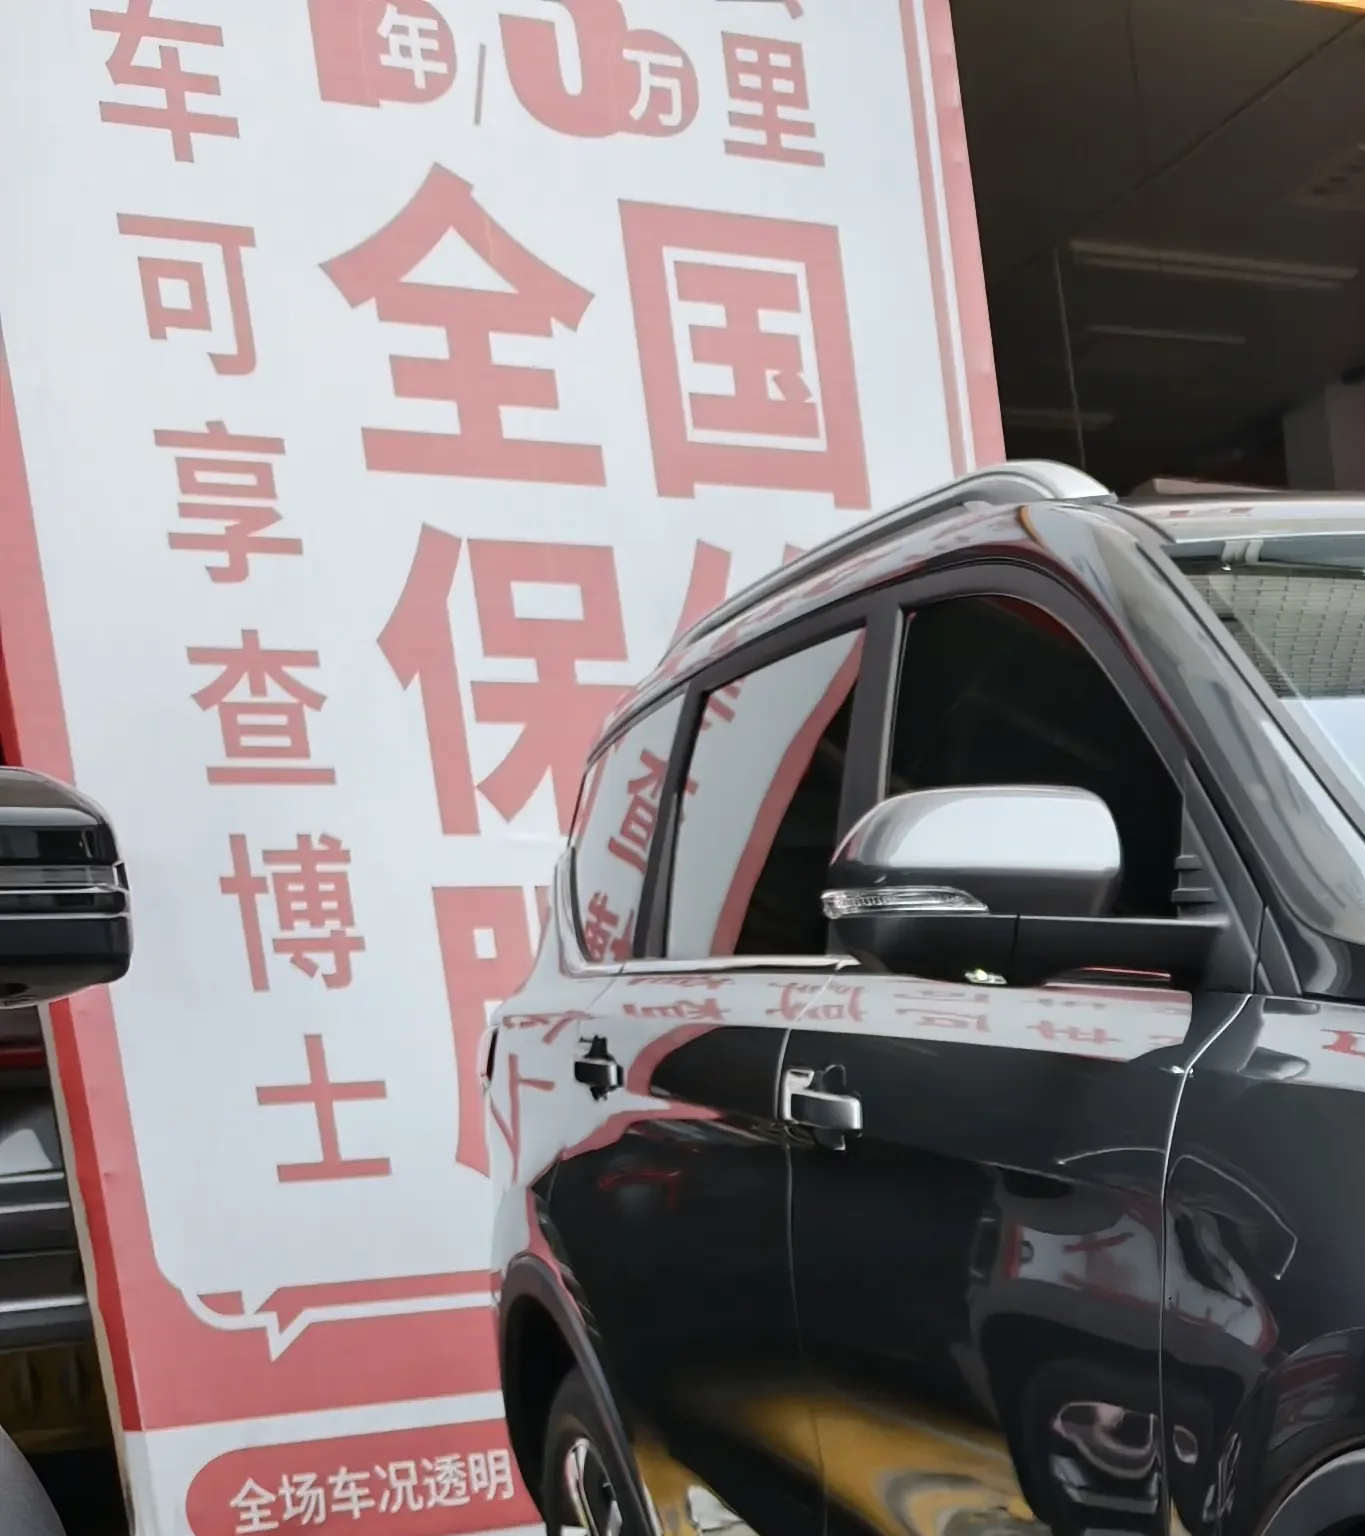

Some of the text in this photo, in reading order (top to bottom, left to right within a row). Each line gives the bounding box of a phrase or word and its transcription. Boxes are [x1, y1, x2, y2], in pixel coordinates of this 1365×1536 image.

[319, 160, 872, 510] 全国
[229, 1448, 515, 1535] 全场车况透明
